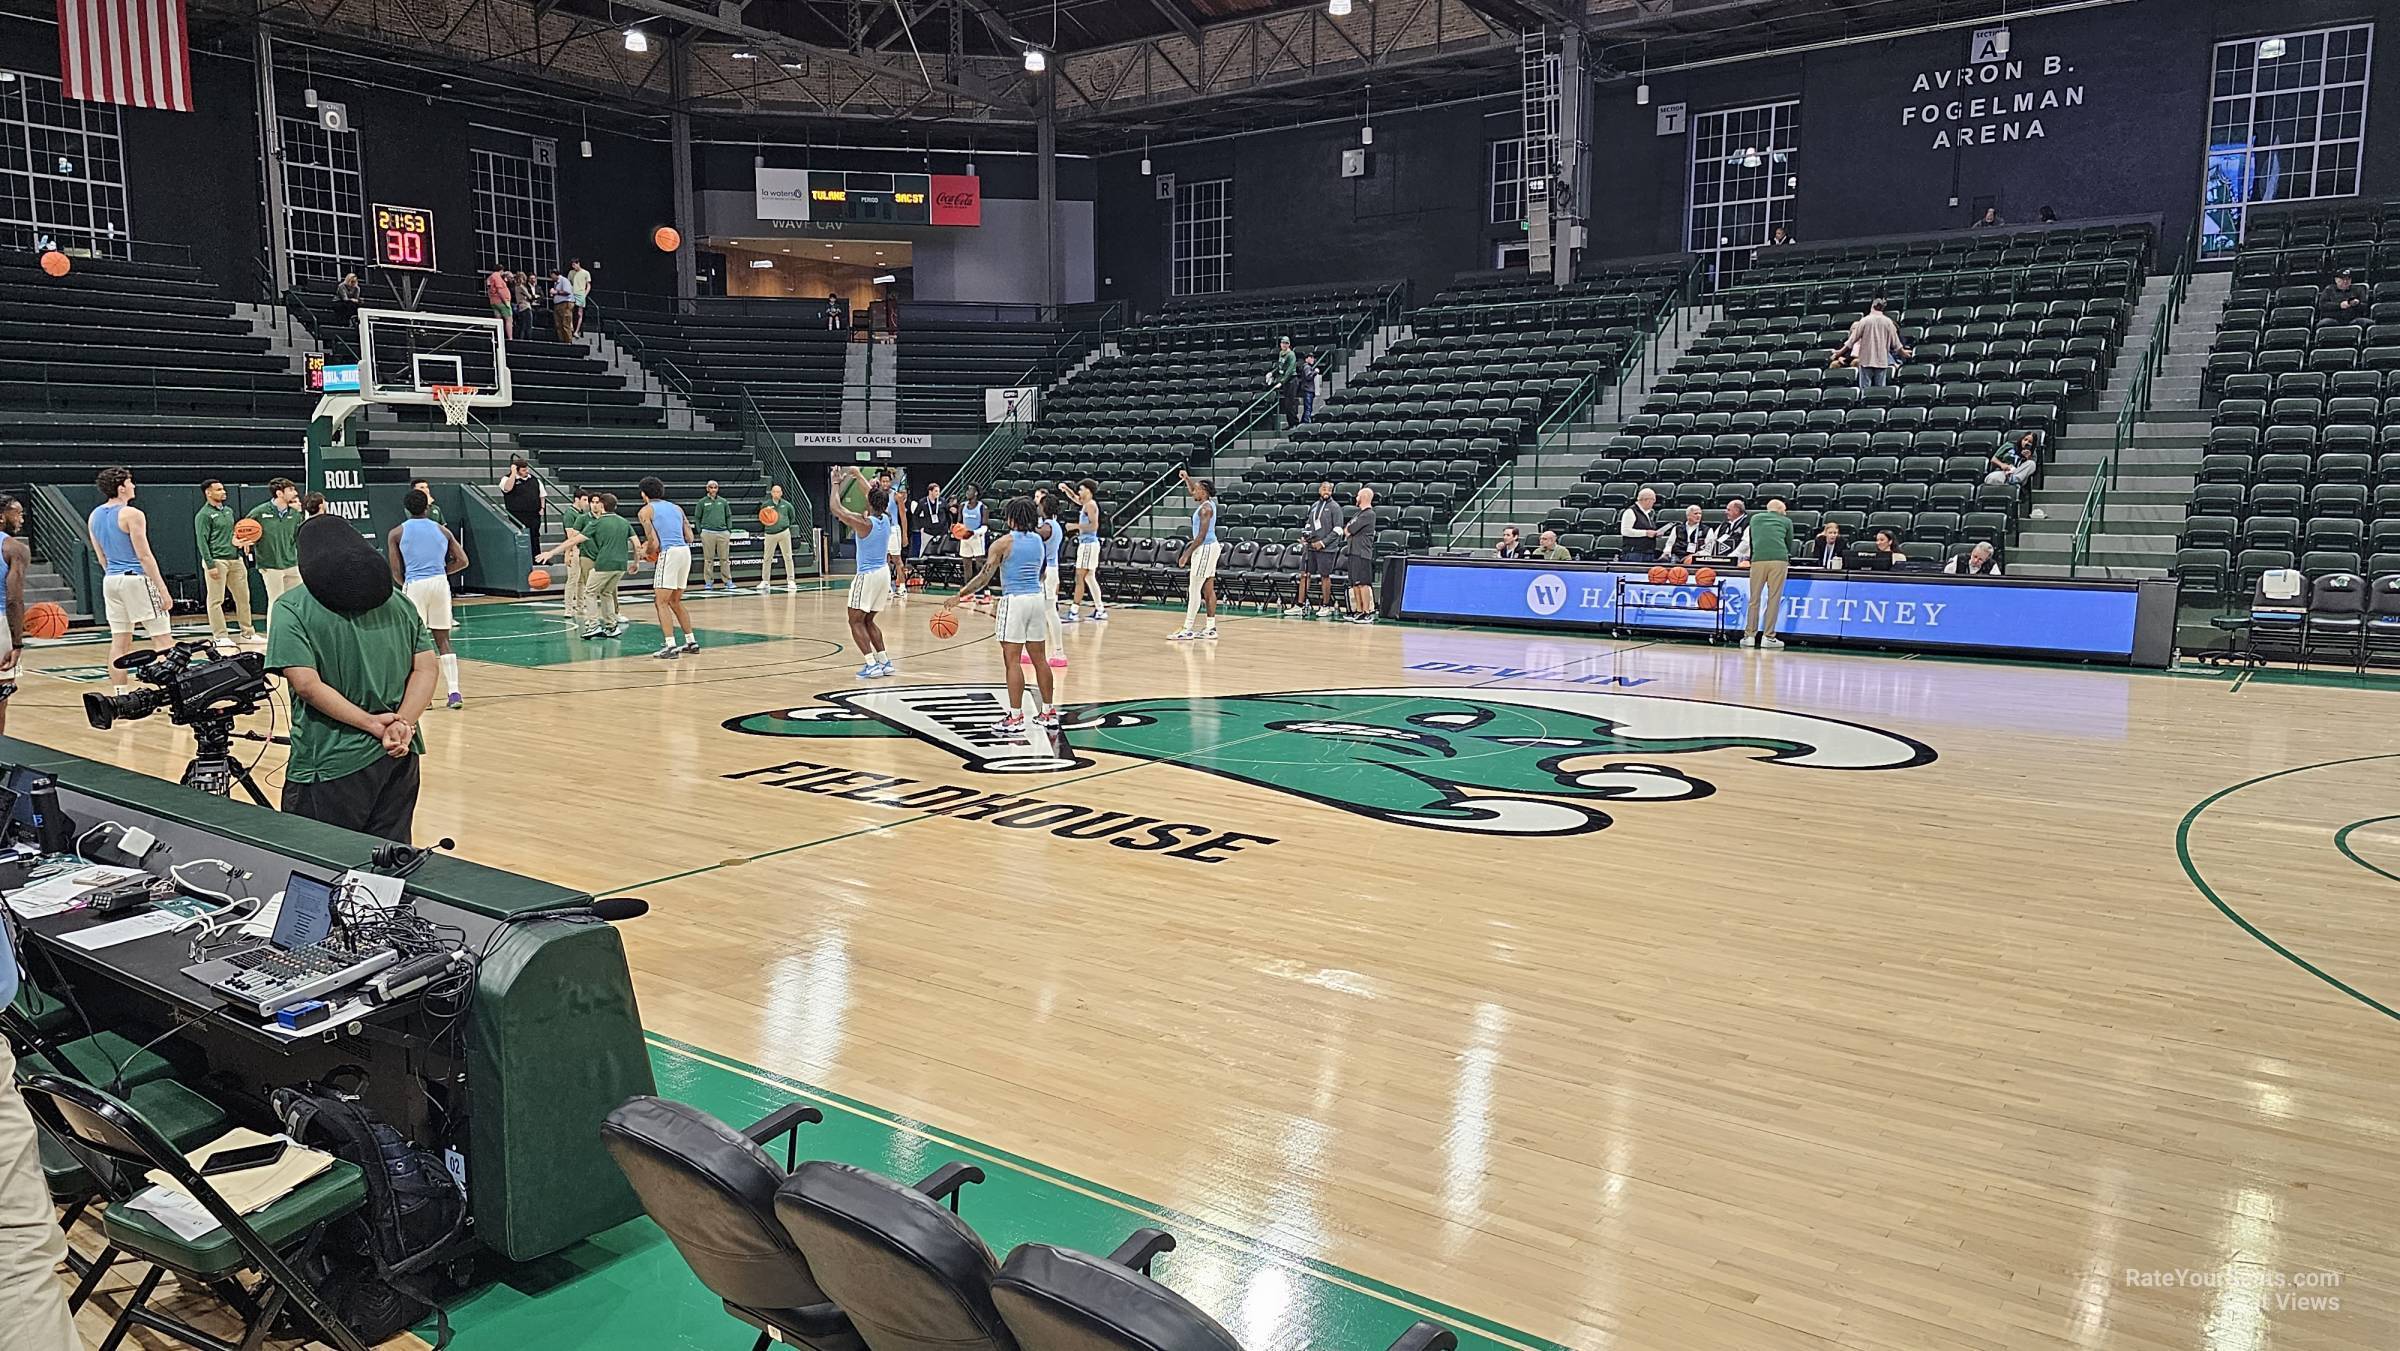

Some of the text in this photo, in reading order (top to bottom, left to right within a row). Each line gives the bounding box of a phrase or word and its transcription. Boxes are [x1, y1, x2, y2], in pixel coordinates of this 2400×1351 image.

[1976, 30, 2005, 38] SECTI
[1980, 40, 1997, 59] A
[1912, 55, 2074, 92] AVRON B.
[1902, 86, 2084, 126] FOGELMAN
[1665, 114, 1678, 130] T
[1932, 119, 2045, 149] ARENA
[540, 149, 550, 163] R
[811, 190, 846, 201] TULANE
[1161, 182, 1170, 196] R
[379, 211, 425, 233] 21:53
[386, 230, 422, 262] 30
[804, 435, 922, 445] PLAYERS COACHES ONLY
[324, 470, 363, 489] ROLL
[325, 500, 370, 520] WAVE
[1579, 587, 1947, 627] HANCOK HITNEY
[721, 760, 1280, 864] FIELDHOUSE
